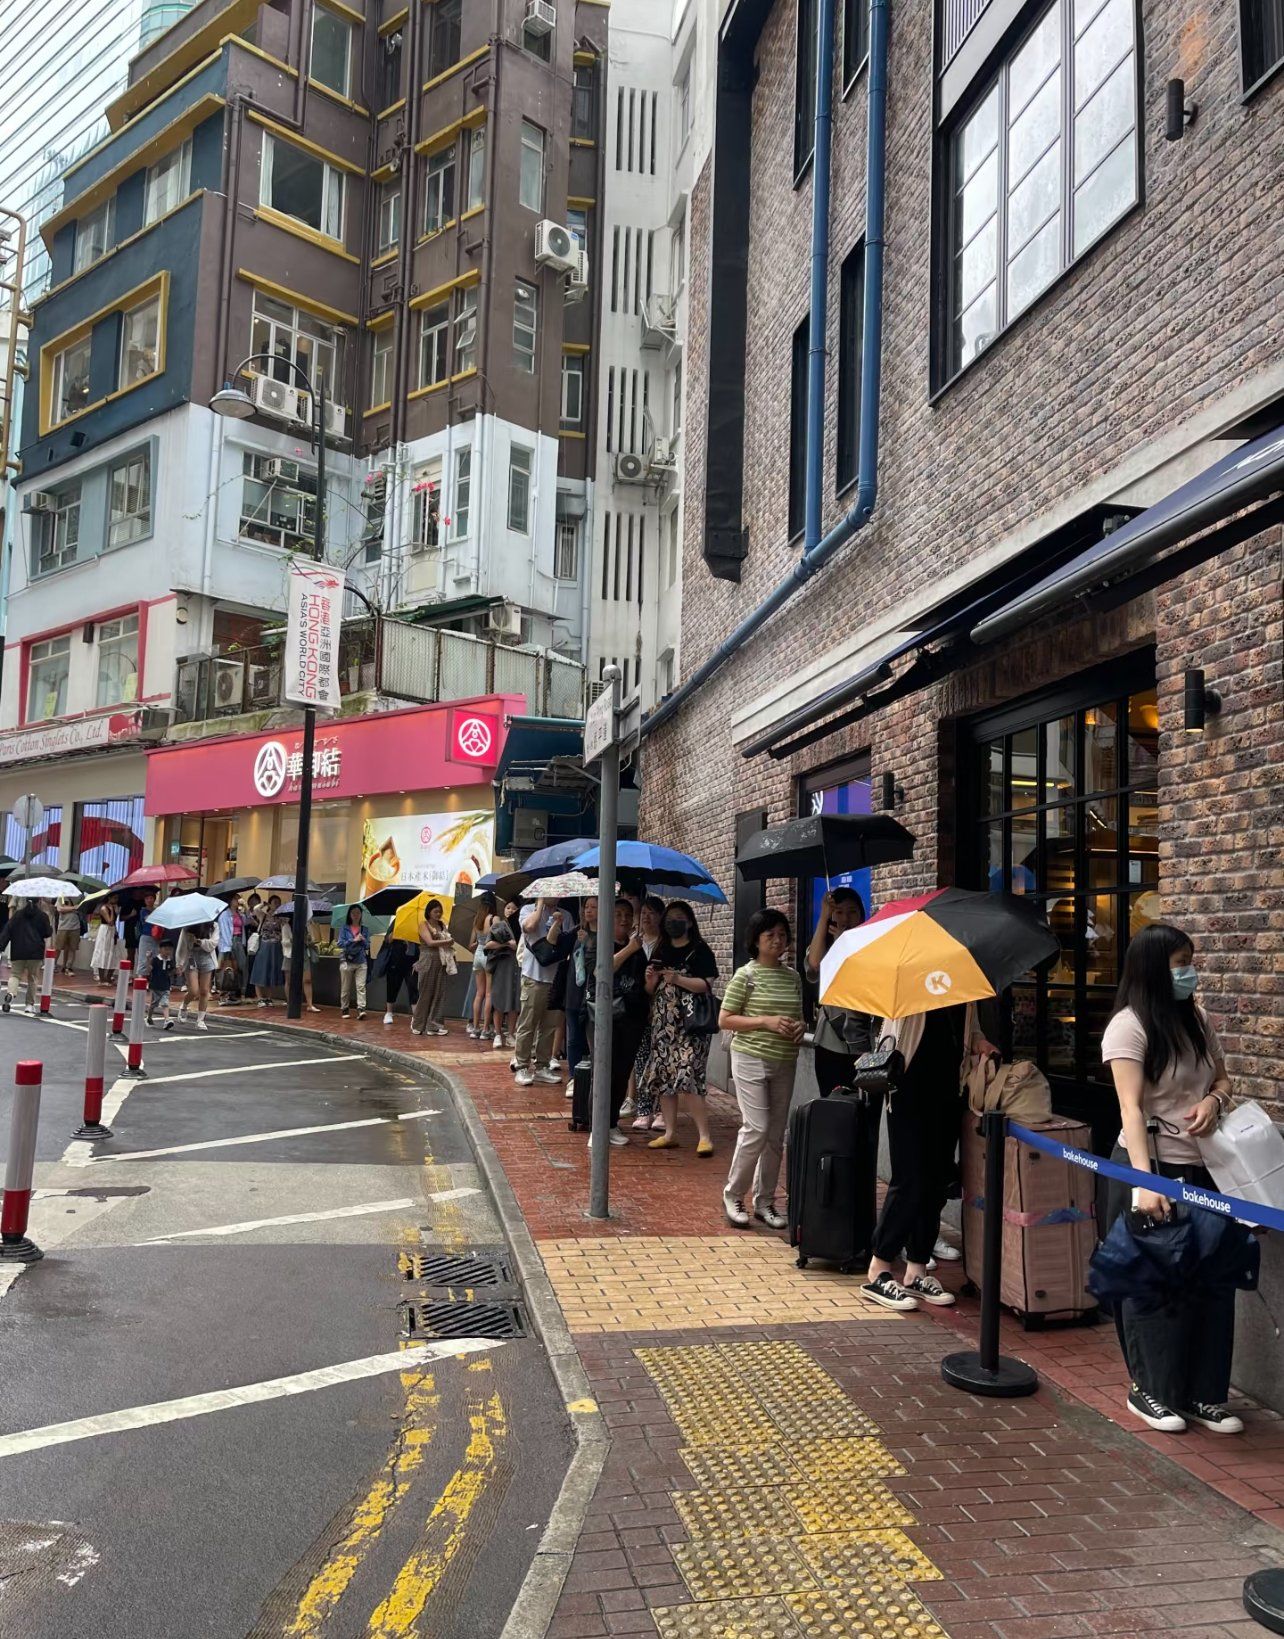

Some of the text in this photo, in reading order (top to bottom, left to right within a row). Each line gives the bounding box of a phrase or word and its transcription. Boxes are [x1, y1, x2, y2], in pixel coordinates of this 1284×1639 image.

[300, 593, 308, 627] ASIA'S
[299, 630, 307, 667] WORLD
[305, 594, 321, 699] HONG KONG
[1063, 1148, 1098, 1170] bakehouse
[1182, 1187, 1231, 1213] bakehouse
